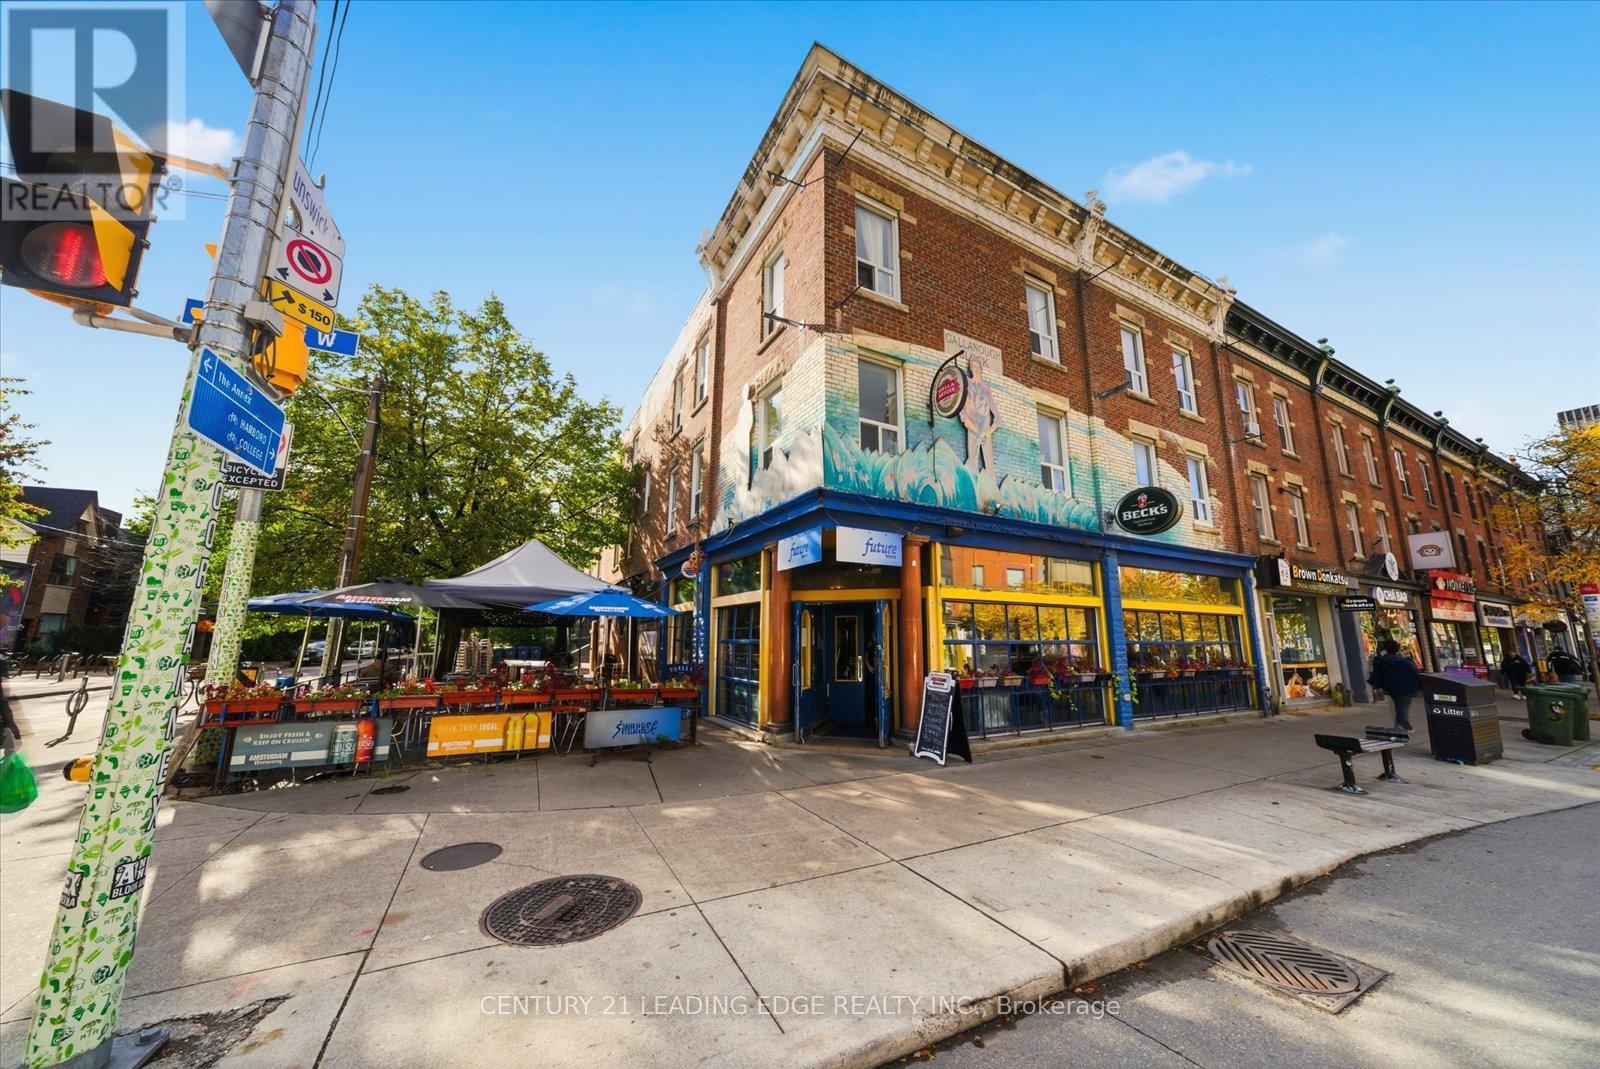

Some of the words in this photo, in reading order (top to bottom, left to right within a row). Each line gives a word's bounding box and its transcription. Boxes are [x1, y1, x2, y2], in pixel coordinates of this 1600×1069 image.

[310, 309, 330, 325] 150
[317, 332, 336, 347] W
[218, 371, 230, 388] The
[240, 419, 267, 445] HARBORD
[238, 438, 263, 460] COLLEGE
[226, 464, 278, 478] BICYCS
[788, 543, 809, 562] future
[862, 537, 898, 556] future
[1292, 565, 1317, 581] Brown
[1317, 568, 1349, 585] Donkatsu
[1443, 707, 1464, 716] Litter
[252, 738, 271, 746] KEEP
[248, 752, 288, 762] AMSTERDAM
